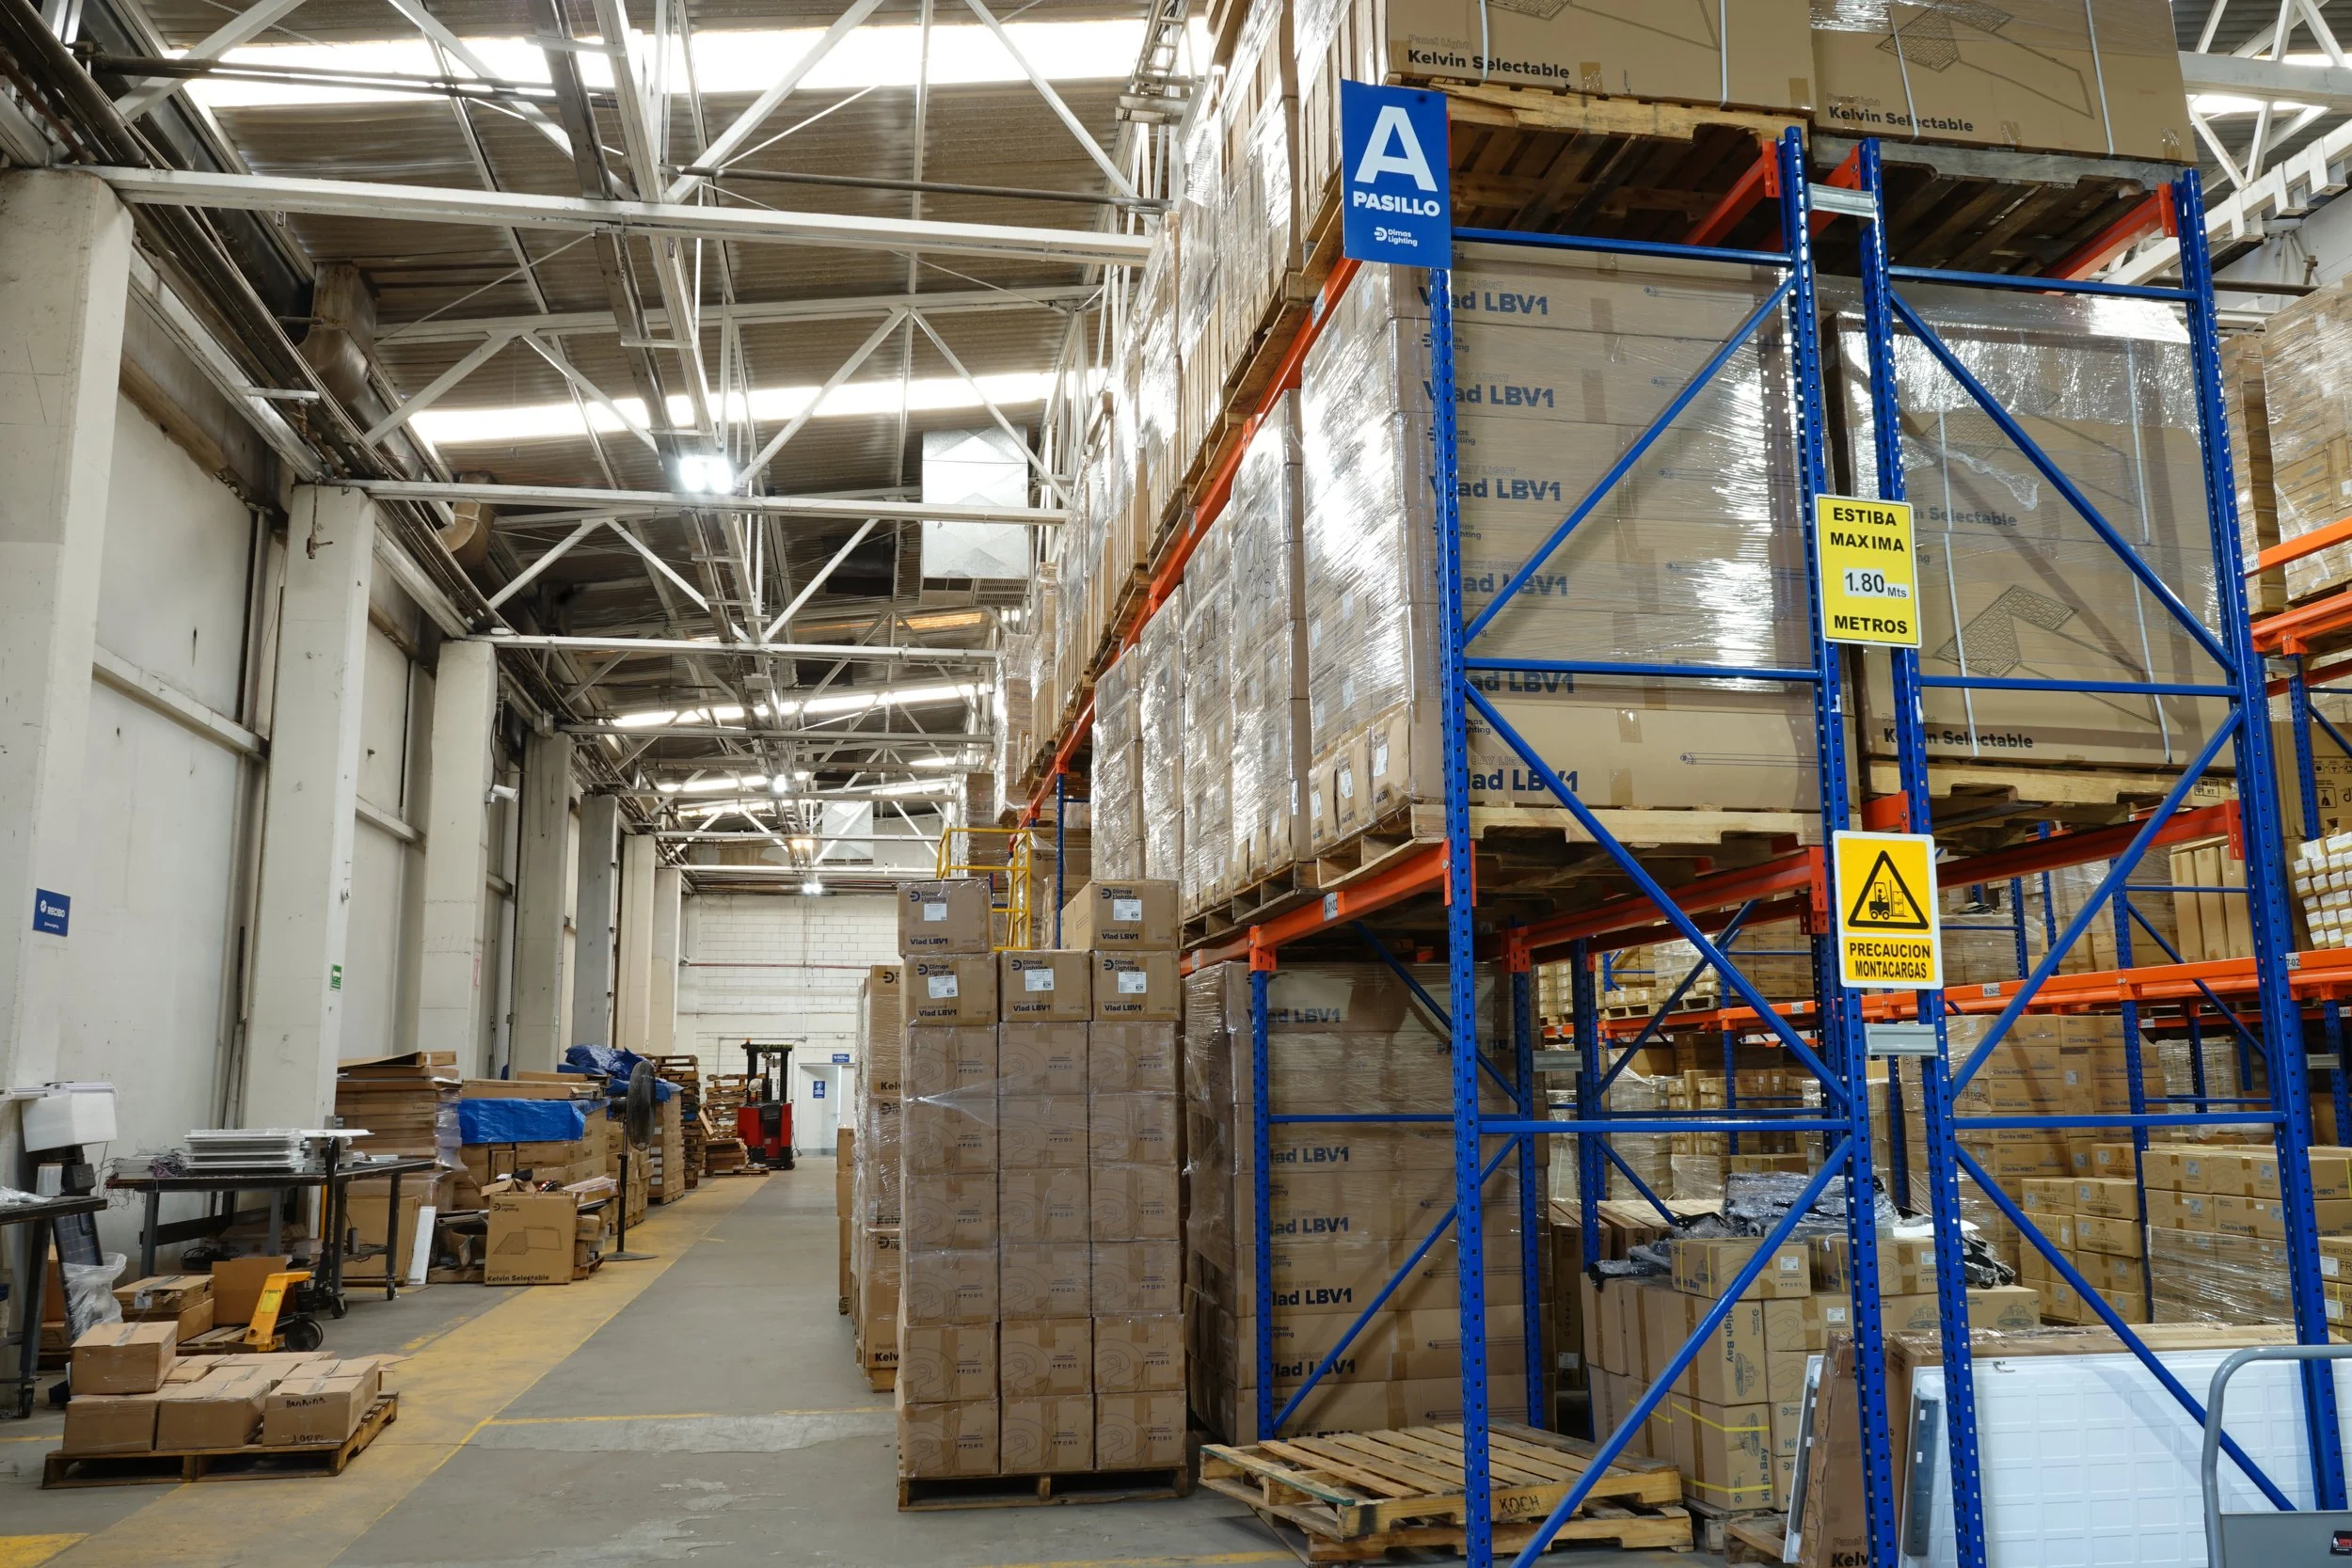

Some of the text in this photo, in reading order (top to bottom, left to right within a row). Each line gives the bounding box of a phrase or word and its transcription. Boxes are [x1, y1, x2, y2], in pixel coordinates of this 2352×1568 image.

[1408, 50, 1569, 78] Kelvin Selectable
[1829, 106, 1974, 132] Kelvin Selectable
[1355, 104, 1438, 192] A
[1353, 191, 1440, 217] PASILLO
[1388, 229, 1411, 238] Dimas
[1388, 236, 1418, 246] Lighting
[1485, 293, 1548, 315] LBV1
[1490, 386, 1554, 407] LBV1
[1497, 479, 1561, 501] LBV1
[1834, 507, 1897, 526] ESTIBA
[1930, 507, 2017, 526] Selectable
[1830, 532, 1904, 552] MAXIMA
[1845, 572, 1907, 598] 1.80 Mts
[1835, 615, 1908, 635] METROS
[1509, 672, 1574, 693] LBV1
[1943, 731, 2033, 748] Selectable
[47, 906, 66, 918] RECIBO
[1849, 942, 1931, 959] PRECAUCION
[1854, 959, 1928, 979] MONTACARGAS
[1295, 1008, 1340, 1023] LBV1
[1303, 1147, 1349, 1163] LBV1
[1303, 1217, 1348, 1234] LBV1
[1690, 1278, 1700, 1291] Bay
[1272, 1288, 1352, 1306] lad LBV1
[1726, 1341, 1735, 1363] Bay
[1760, 1449, 1769, 1470] Bay
